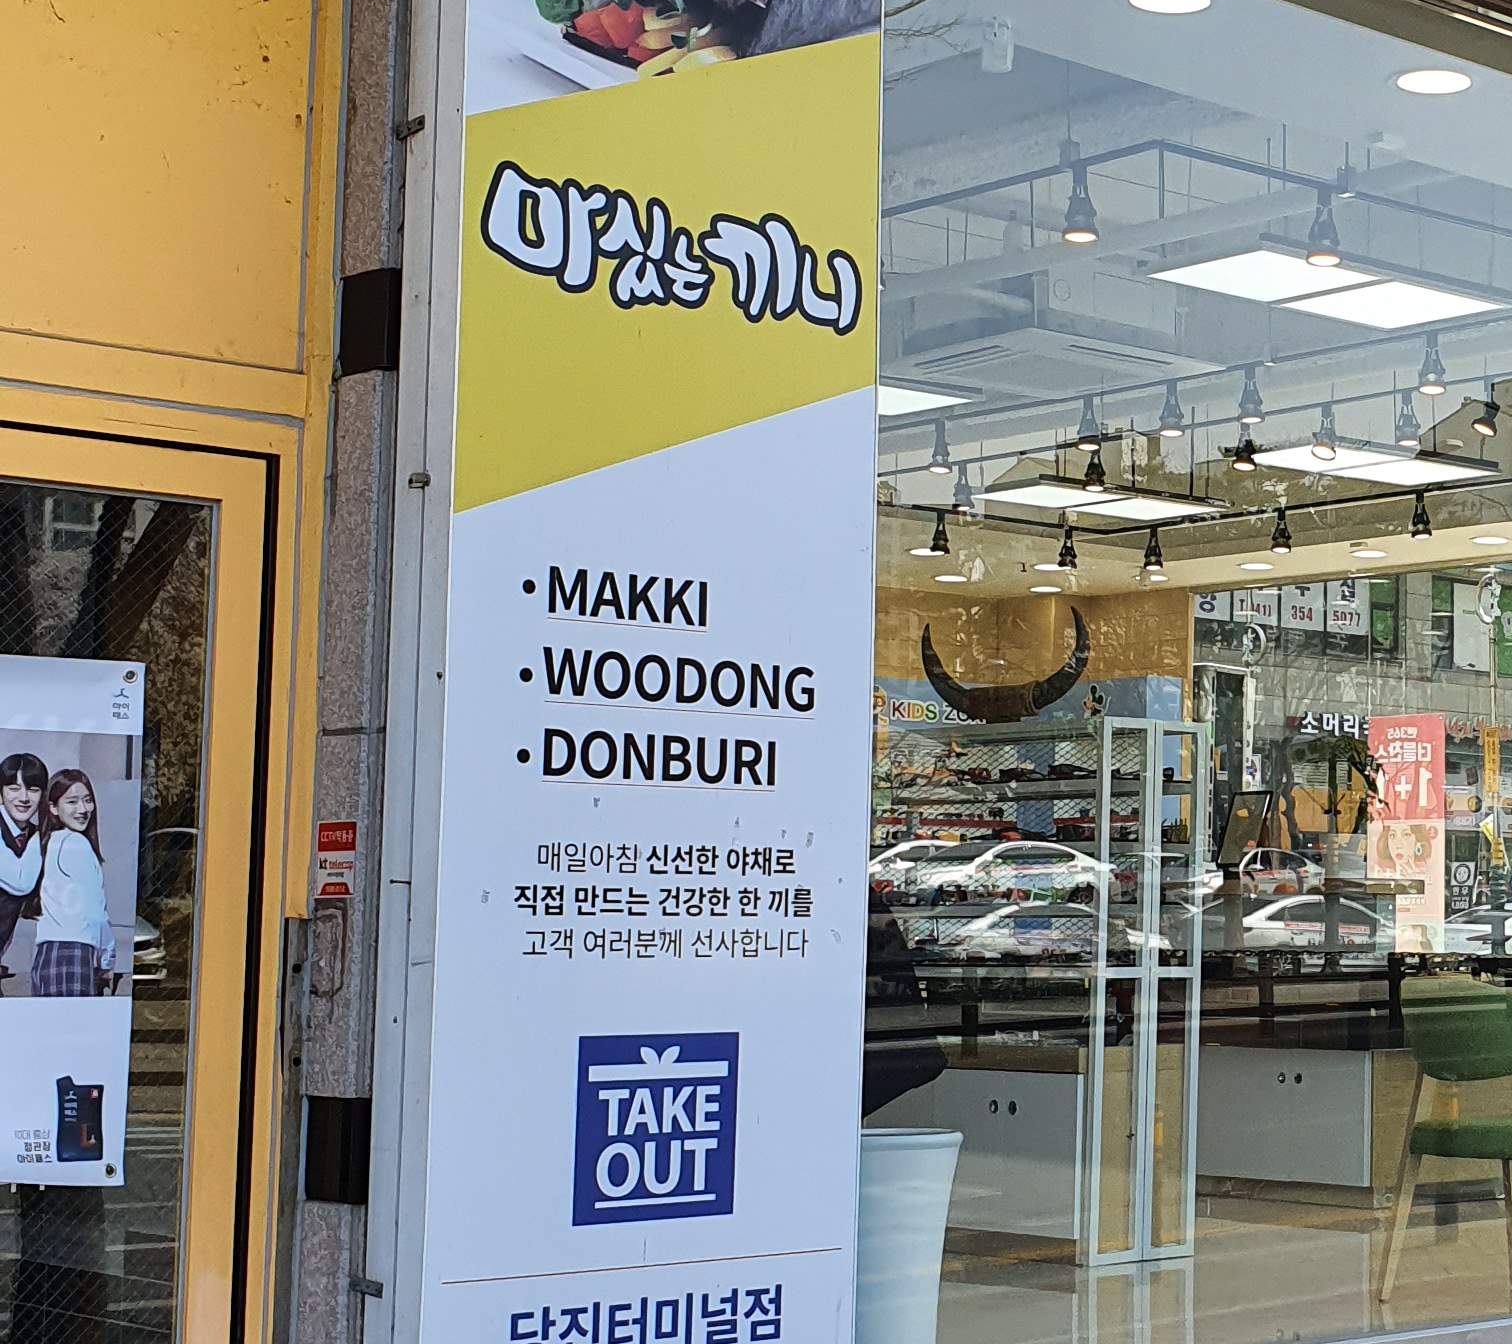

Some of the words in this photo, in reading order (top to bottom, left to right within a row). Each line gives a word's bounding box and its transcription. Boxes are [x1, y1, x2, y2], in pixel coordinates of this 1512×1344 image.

[547, 565, 708, 627] MAKKI
[1291, 605, 1313, 622] 354
[543, 645, 815, 713] WOODONG
[890, 699, 938, 722] KIDS
[542, 727, 776, 787] DONBURI
[537, 840, 639, 875] 매일아침
[646, 844, 719, 876] 신선한
[726, 846, 796, 877] 야채로
[513, 884, 565, 917] 직접
[574, 885, 650, 917] 만드는
[658, 886, 730, 917] 건강한
[738, 886, 761, 918] 한
[768, 887, 815, 918] 끼를
[522, 928, 575, 959] 고객
[583, 928, 682, 960] 여러분께
[690, 929, 809, 959] 선사합니다
[598, 1084, 721, 1136] TAKE
[596, 1138, 718, 1198] OUT
